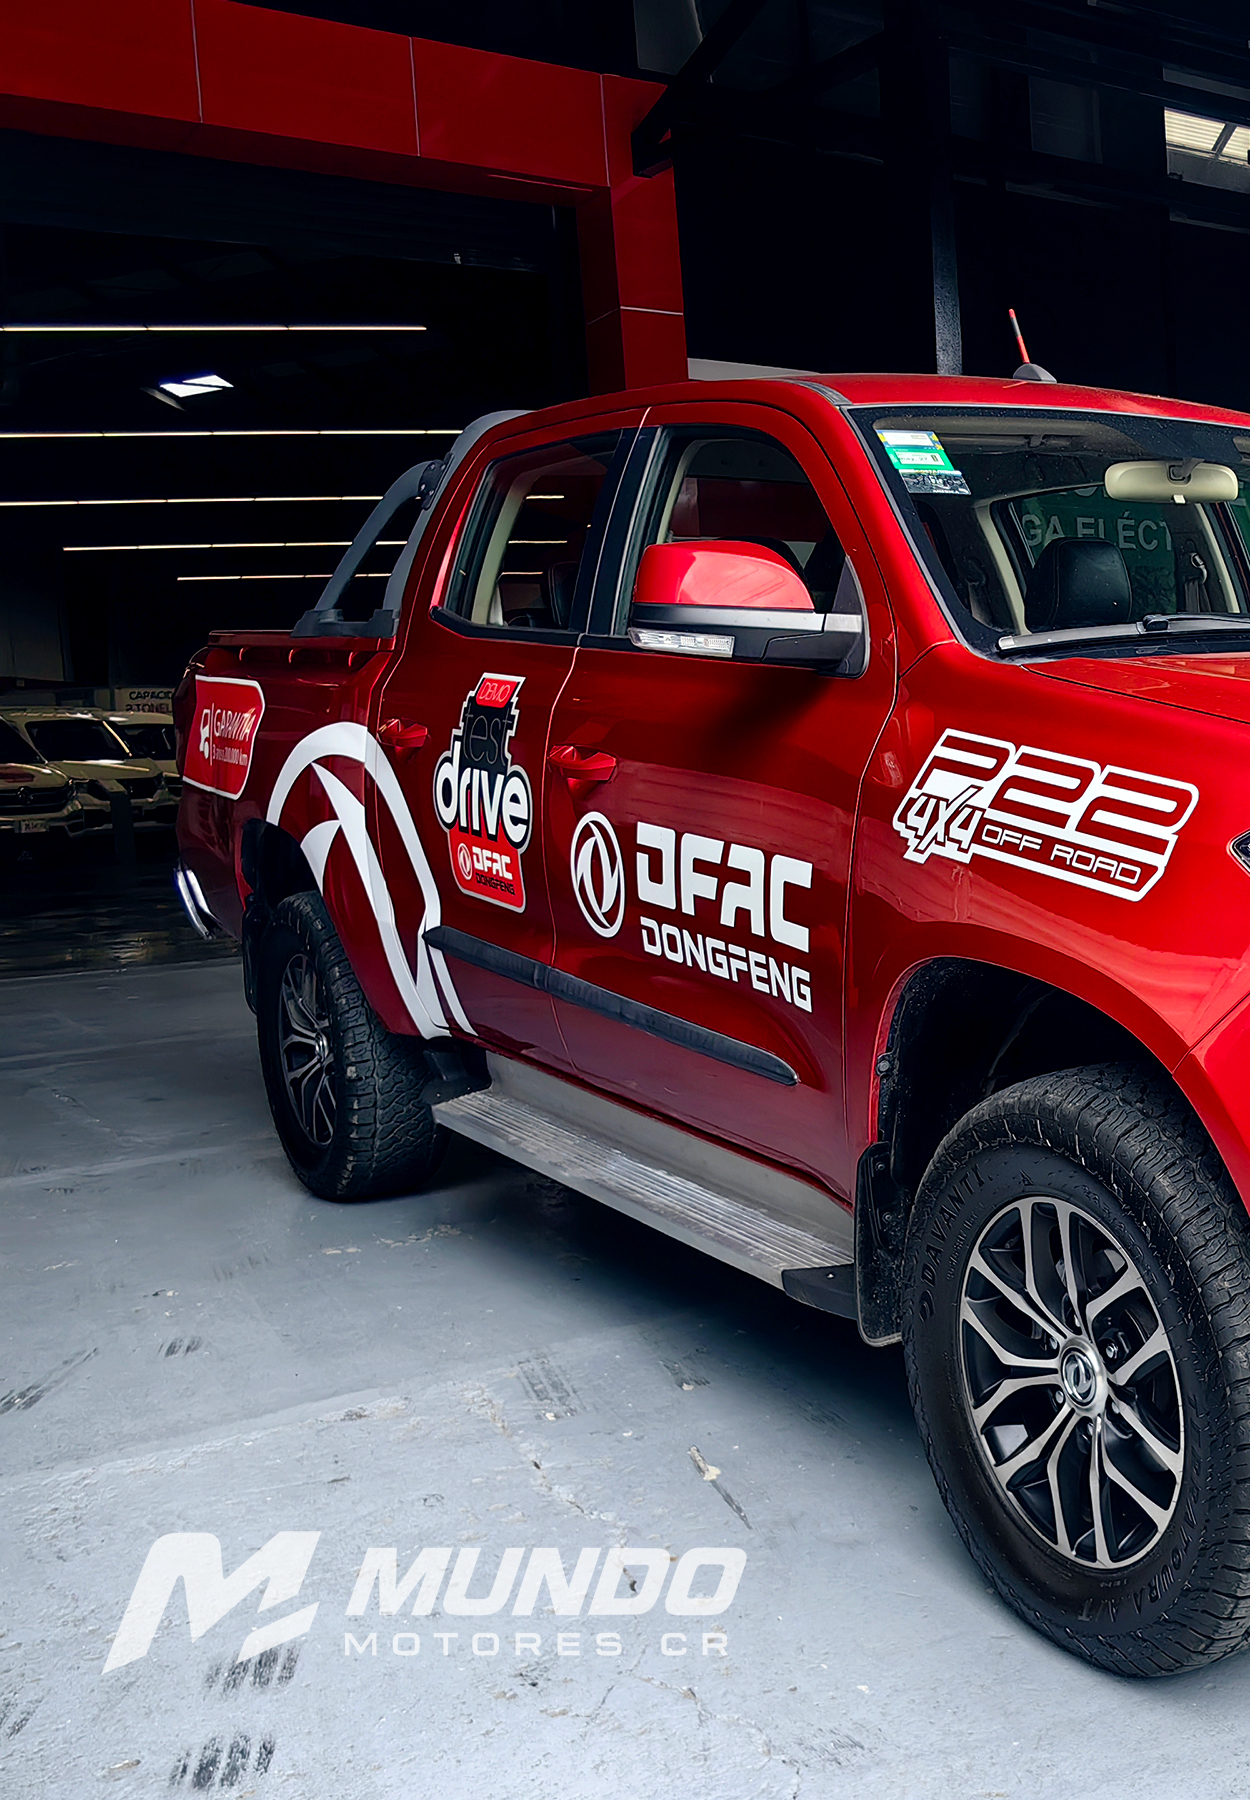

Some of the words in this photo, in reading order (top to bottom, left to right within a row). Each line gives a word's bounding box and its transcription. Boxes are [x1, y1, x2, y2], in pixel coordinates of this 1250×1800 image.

[479, 682, 511, 703] DEMO
[463, 702, 512, 766] test
[436, 740, 529, 843] drive
[472, 845, 514, 880] DFAC
[475, 872, 516, 896] DONGFENG
[981, 826, 1043, 851] OFF
[1050, 843, 1142, 885] ROAD
[636, 821, 813, 953] DFAC
[639, 916, 813, 1013] DONGFENG
